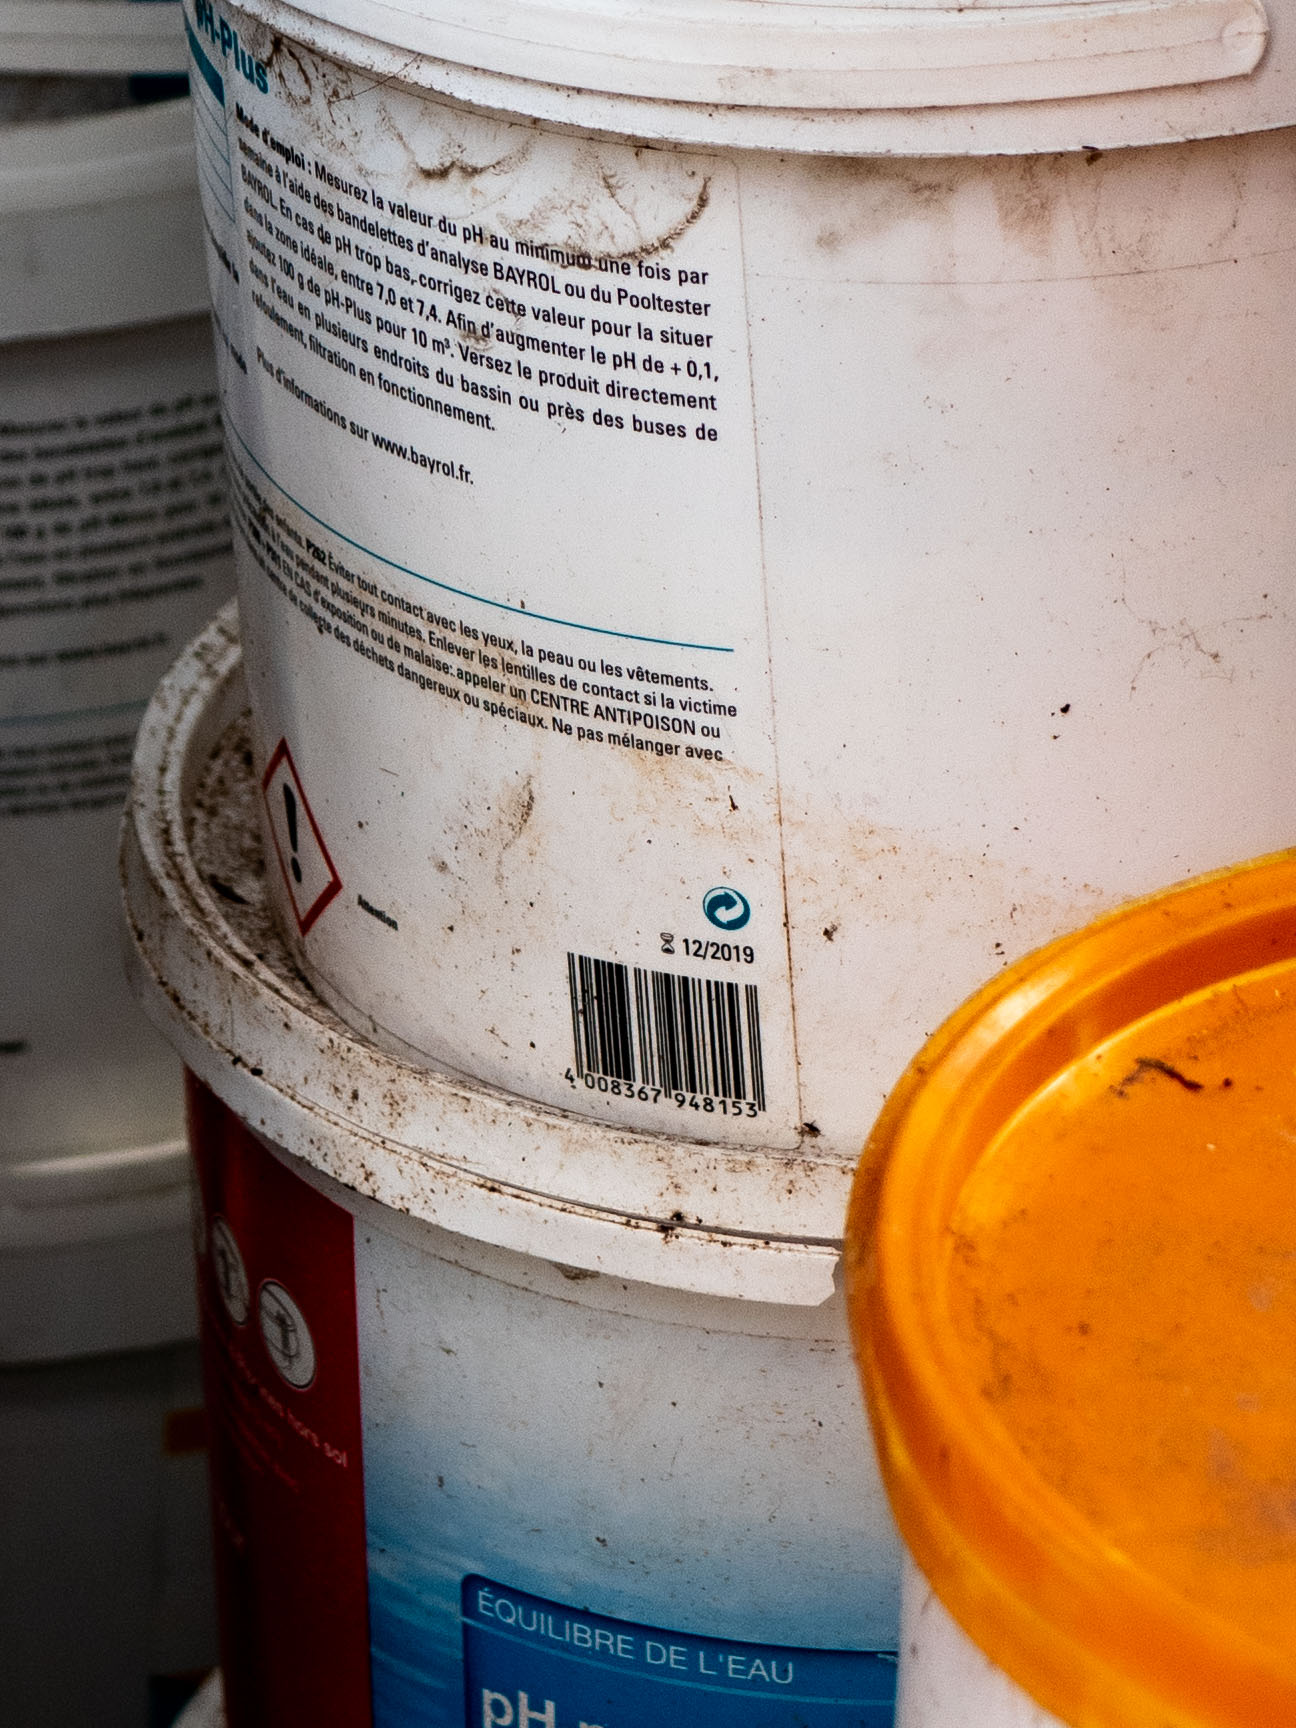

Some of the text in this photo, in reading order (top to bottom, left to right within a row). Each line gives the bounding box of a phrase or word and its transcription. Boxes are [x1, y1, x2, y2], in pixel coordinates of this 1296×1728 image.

[314, 161, 708, 286] Mesurez la valeur du pH au minimum une fois par
[336, 203, 711, 317] bandelettes d'analyse BAYROL ou du Pooltester
[419, 271, 713, 348] corrigez cette valeur pour la situer
[457, 342, 718, 411] Versez le produit directement
[481, 321, 585, 360] d'augmenter
[591, 346, 607, 364] le
[613, 352, 636, 371] pH
[642, 356, 664, 373] de
[378, 374, 496, 431] fonctionnement.
[460, 374, 718, 441] bassin ou près des buses de
[482, 632, 714, 692] yeux, la peau ou les vêtements.
[531, 689, 720, 738] CENTRE ANTIPOISON ou
[608, 732, 723, 761] mélanger avec
[682, 938, 755, 964] 12/2019
[565, 1067, 758, 1118] 4 008367 948153
[477, 1588, 794, 1685] ÉQUILIBRE DE L'EAU
